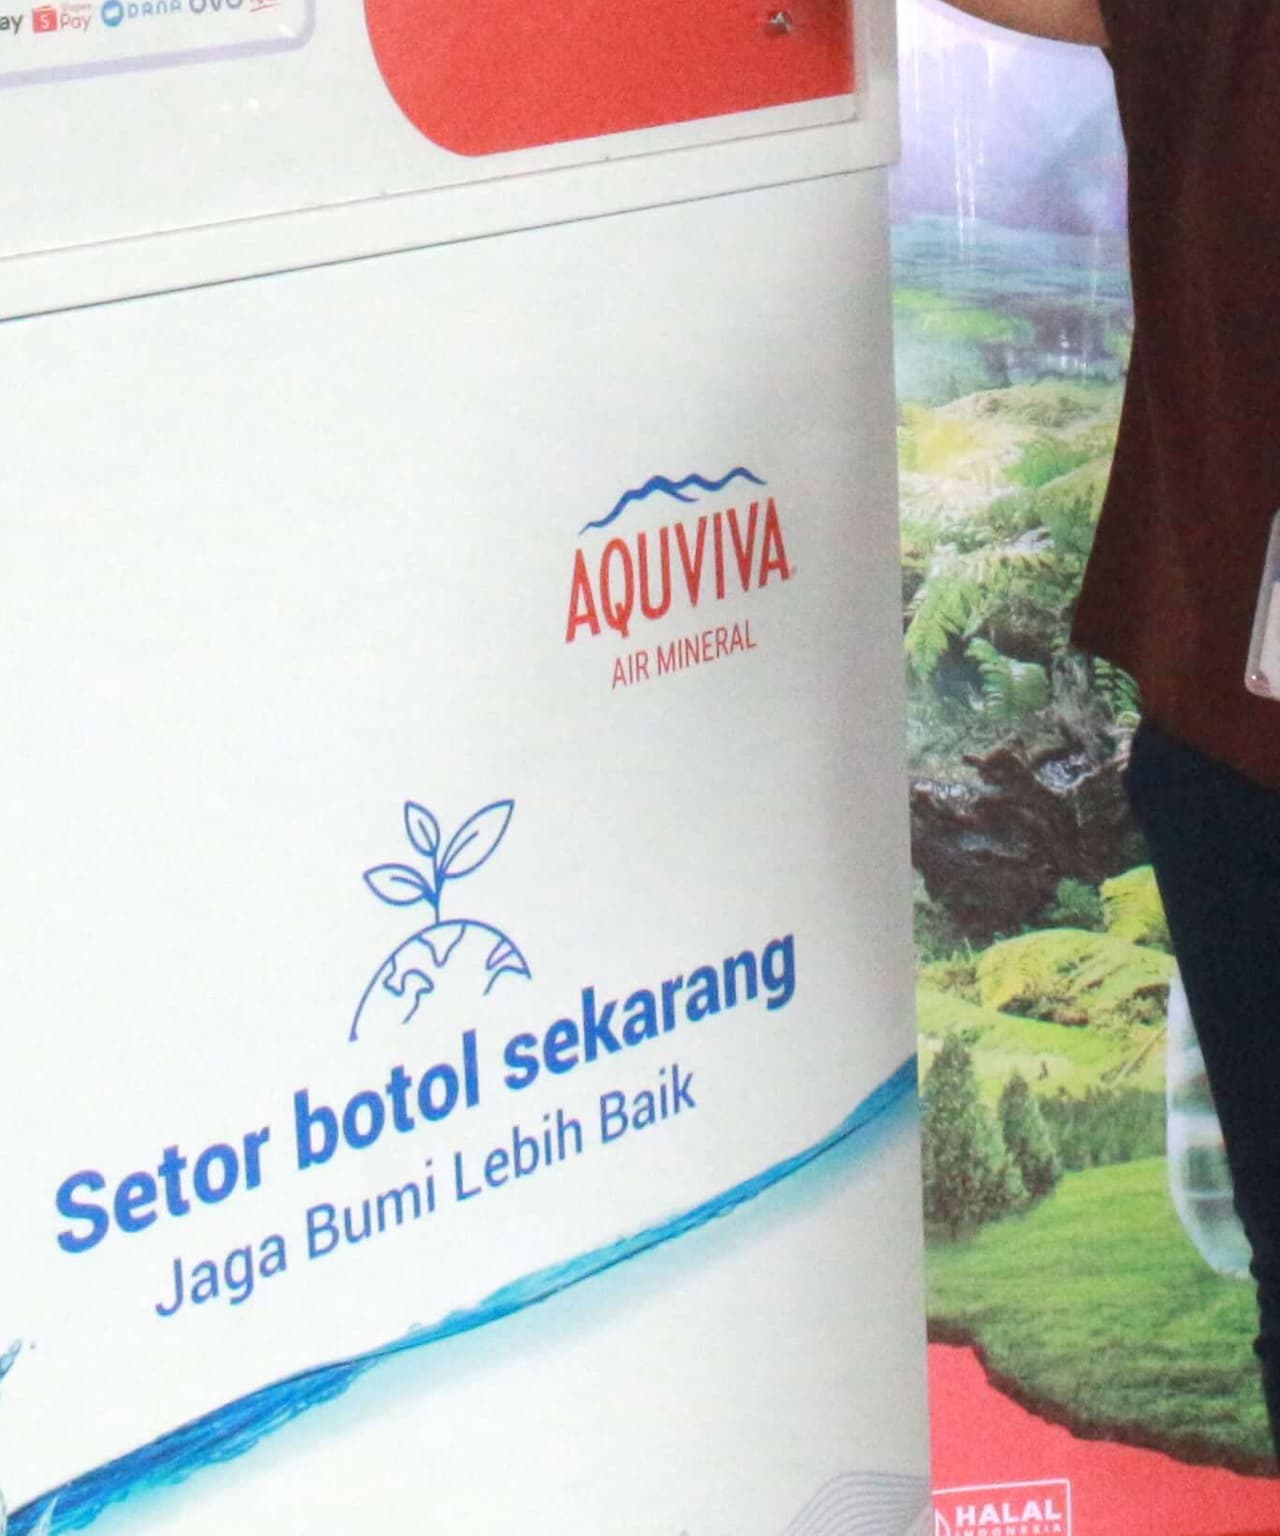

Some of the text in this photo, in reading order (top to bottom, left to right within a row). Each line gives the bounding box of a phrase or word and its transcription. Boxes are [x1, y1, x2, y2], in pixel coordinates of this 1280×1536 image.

[60, 13, 93, 35] Pay
[565, 497, 790, 644] AQUVIVA
[612, 619, 757, 690] AIR MINERAL
[55, 934, 796, 1253] Setor botol sekarang
[155, 1063, 696, 1317] Jaga Bumi Lebih Baik
[956, 1498, 1062, 1527] HALAL
